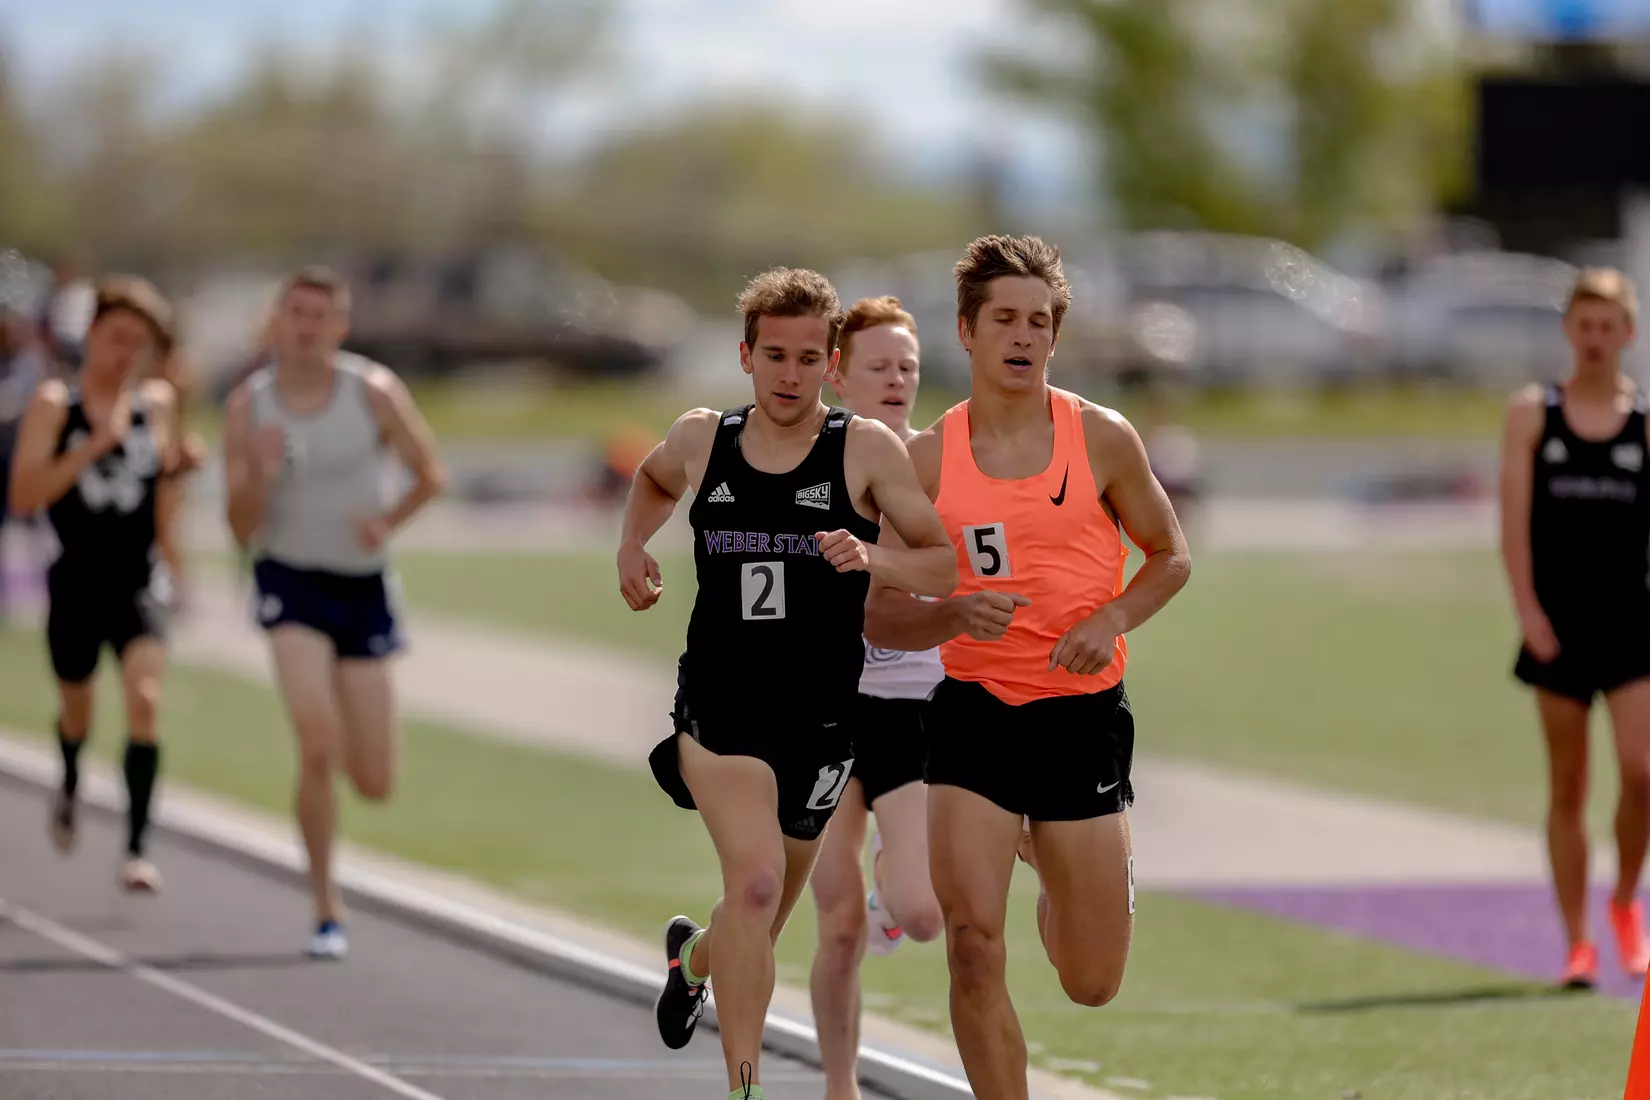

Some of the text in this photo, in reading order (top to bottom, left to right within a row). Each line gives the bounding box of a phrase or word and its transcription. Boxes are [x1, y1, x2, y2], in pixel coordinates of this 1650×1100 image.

[708, 495, 735, 503] adidas
[704, 530, 820, 556] WEBER STAT
[974, 527, 1001, 576] 5
[751, 565, 777, 617] 2
[815, 762, 846, 807] 2
